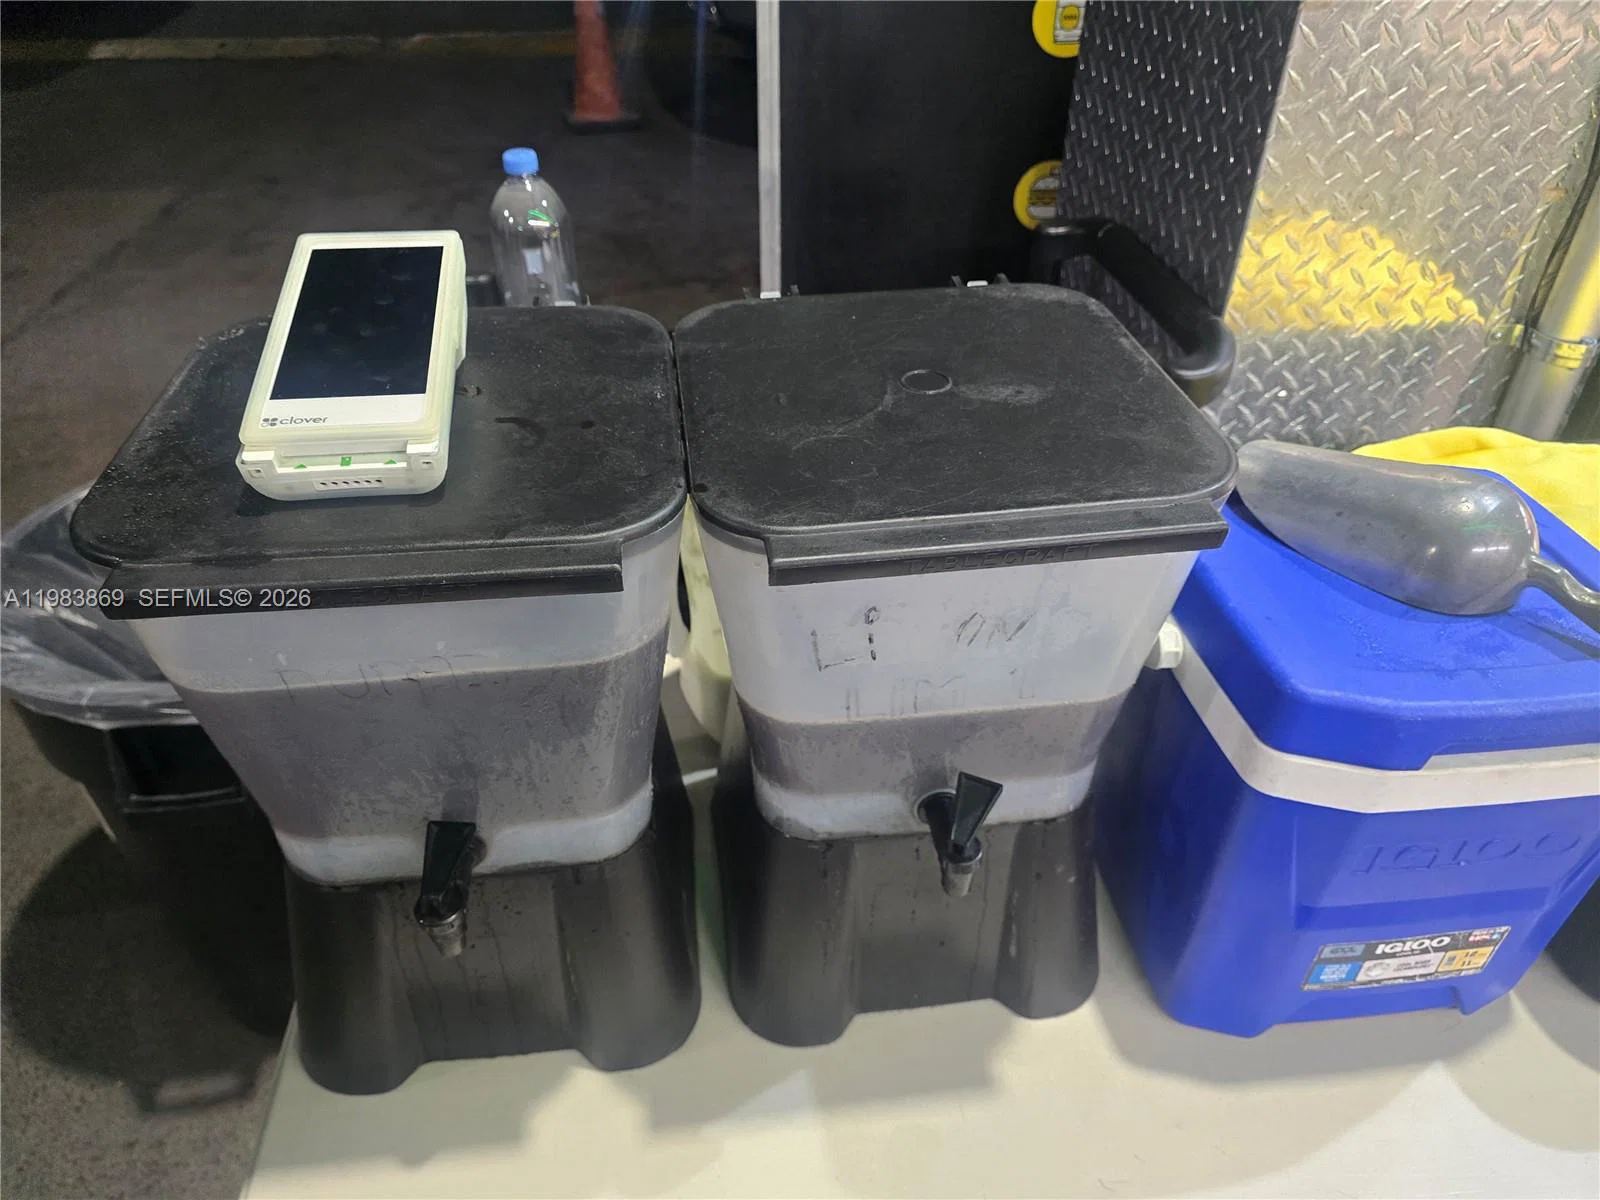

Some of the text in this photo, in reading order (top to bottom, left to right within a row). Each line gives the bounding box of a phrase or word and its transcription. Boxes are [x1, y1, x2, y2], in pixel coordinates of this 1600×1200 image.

[279, 415, 328, 426] clover
[903, 545, 1098, 573] TABLECRAFT
[1374, 935, 1452, 955] IGLOO
